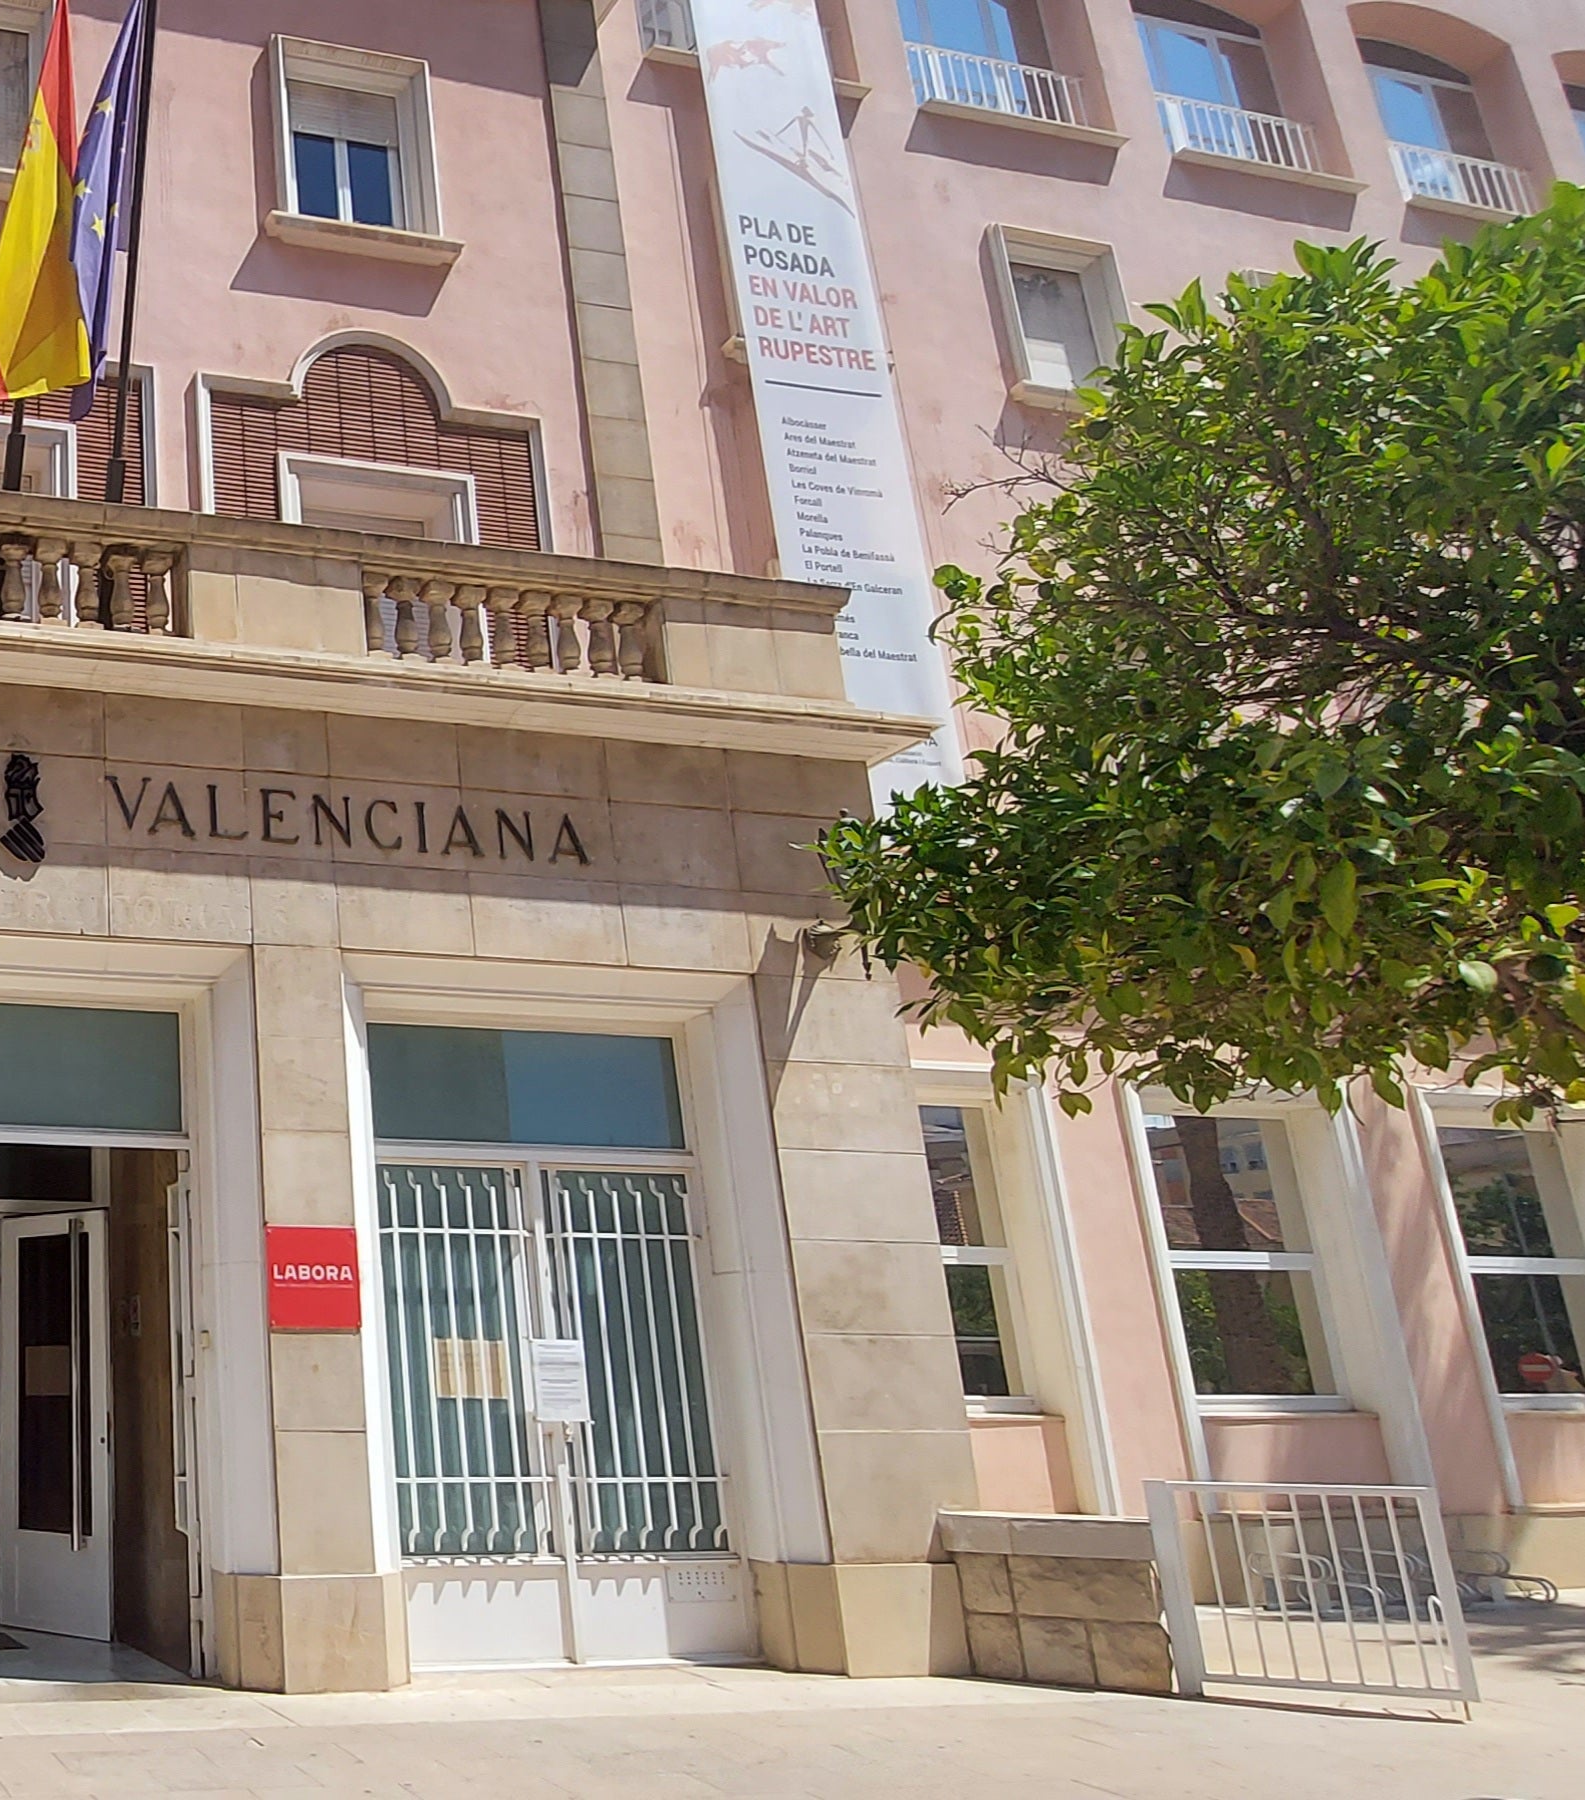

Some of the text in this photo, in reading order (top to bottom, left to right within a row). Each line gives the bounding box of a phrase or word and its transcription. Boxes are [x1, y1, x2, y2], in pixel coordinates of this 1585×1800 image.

[739, 215, 816, 246] PLA DE
[744, 245, 835, 278] POSADA
[749, 275, 858, 309] EN VALOR
[754, 305, 850, 338] DE L' ART
[758, 336, 877, 371] RUPESTRE
[784, 432, 856, 449] Ares del Maestrat
[825, 453, 837, 463] del
[839, 454, 876, 467] Maestrat
[791, 479, 807, 490] Les
[808, 482, 834, 493] Coves
[836, 485, 846, 495] de
[797, 511, 829, 524] Morella
[799, 528, 844, 541] Palanques
[802, 544, 813, 554] La
[815, 545, 839, 557] Pobla
[840, 548, 851, 559] de
[805, 560, 843, 573] El Portell
[864, 583, 903, 595] Galceran
[863, 648, 876, 659] del
[878, 650, 918, 663] Maestrat
[105, 774, 592, 868] VALENCIANA
[273, 1264, 353, 1281] LABORA
